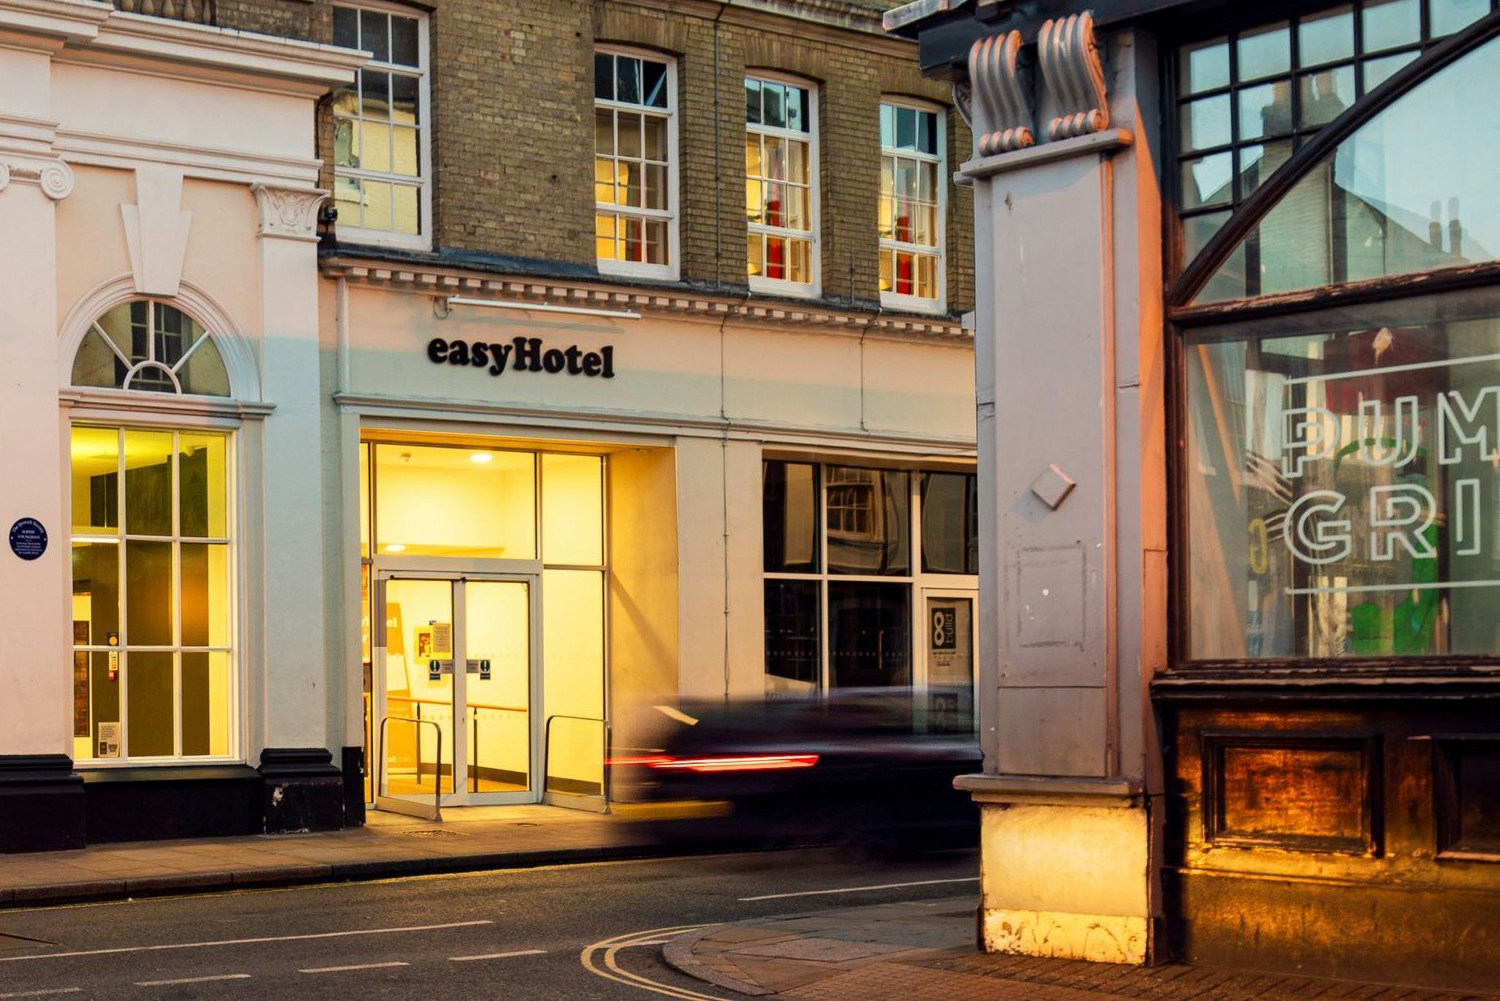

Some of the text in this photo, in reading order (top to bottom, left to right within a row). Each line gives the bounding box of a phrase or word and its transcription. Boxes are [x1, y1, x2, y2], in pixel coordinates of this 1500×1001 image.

[427, 336, 615, 378] easyHotel
[1282, 386, 1500, 478] PUM
[1282, 478, 1482, 565] GRI
